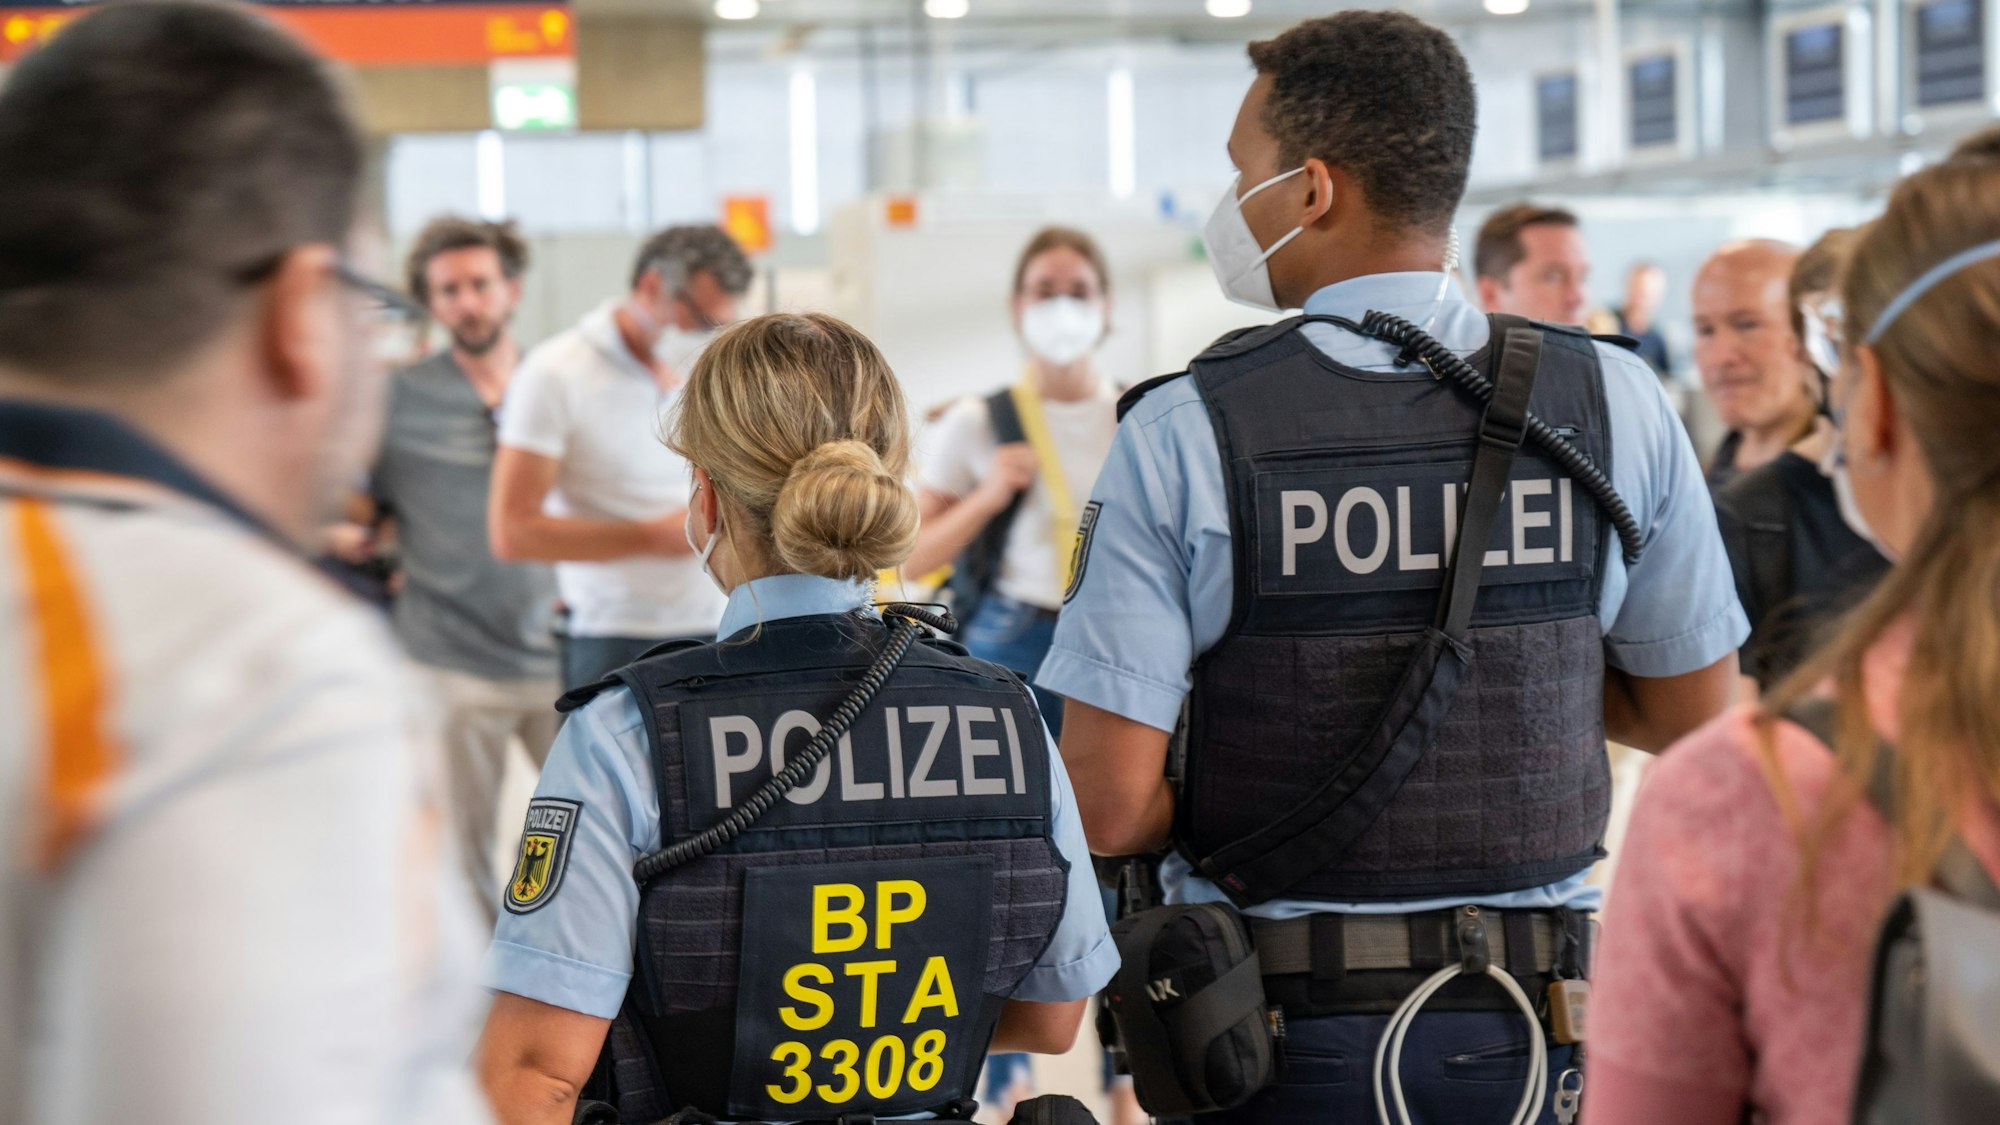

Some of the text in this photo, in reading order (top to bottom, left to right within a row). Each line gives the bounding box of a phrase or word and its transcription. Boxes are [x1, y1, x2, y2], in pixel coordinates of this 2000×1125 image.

[709, 705, 1026, 809] POLIZEI
[527, 808, 570, 832] POLIZEI
[812, 879, 927, 954] BP
[778, 955, 960, 1031] STA
[765, 1028, 947, 1104] 3308
